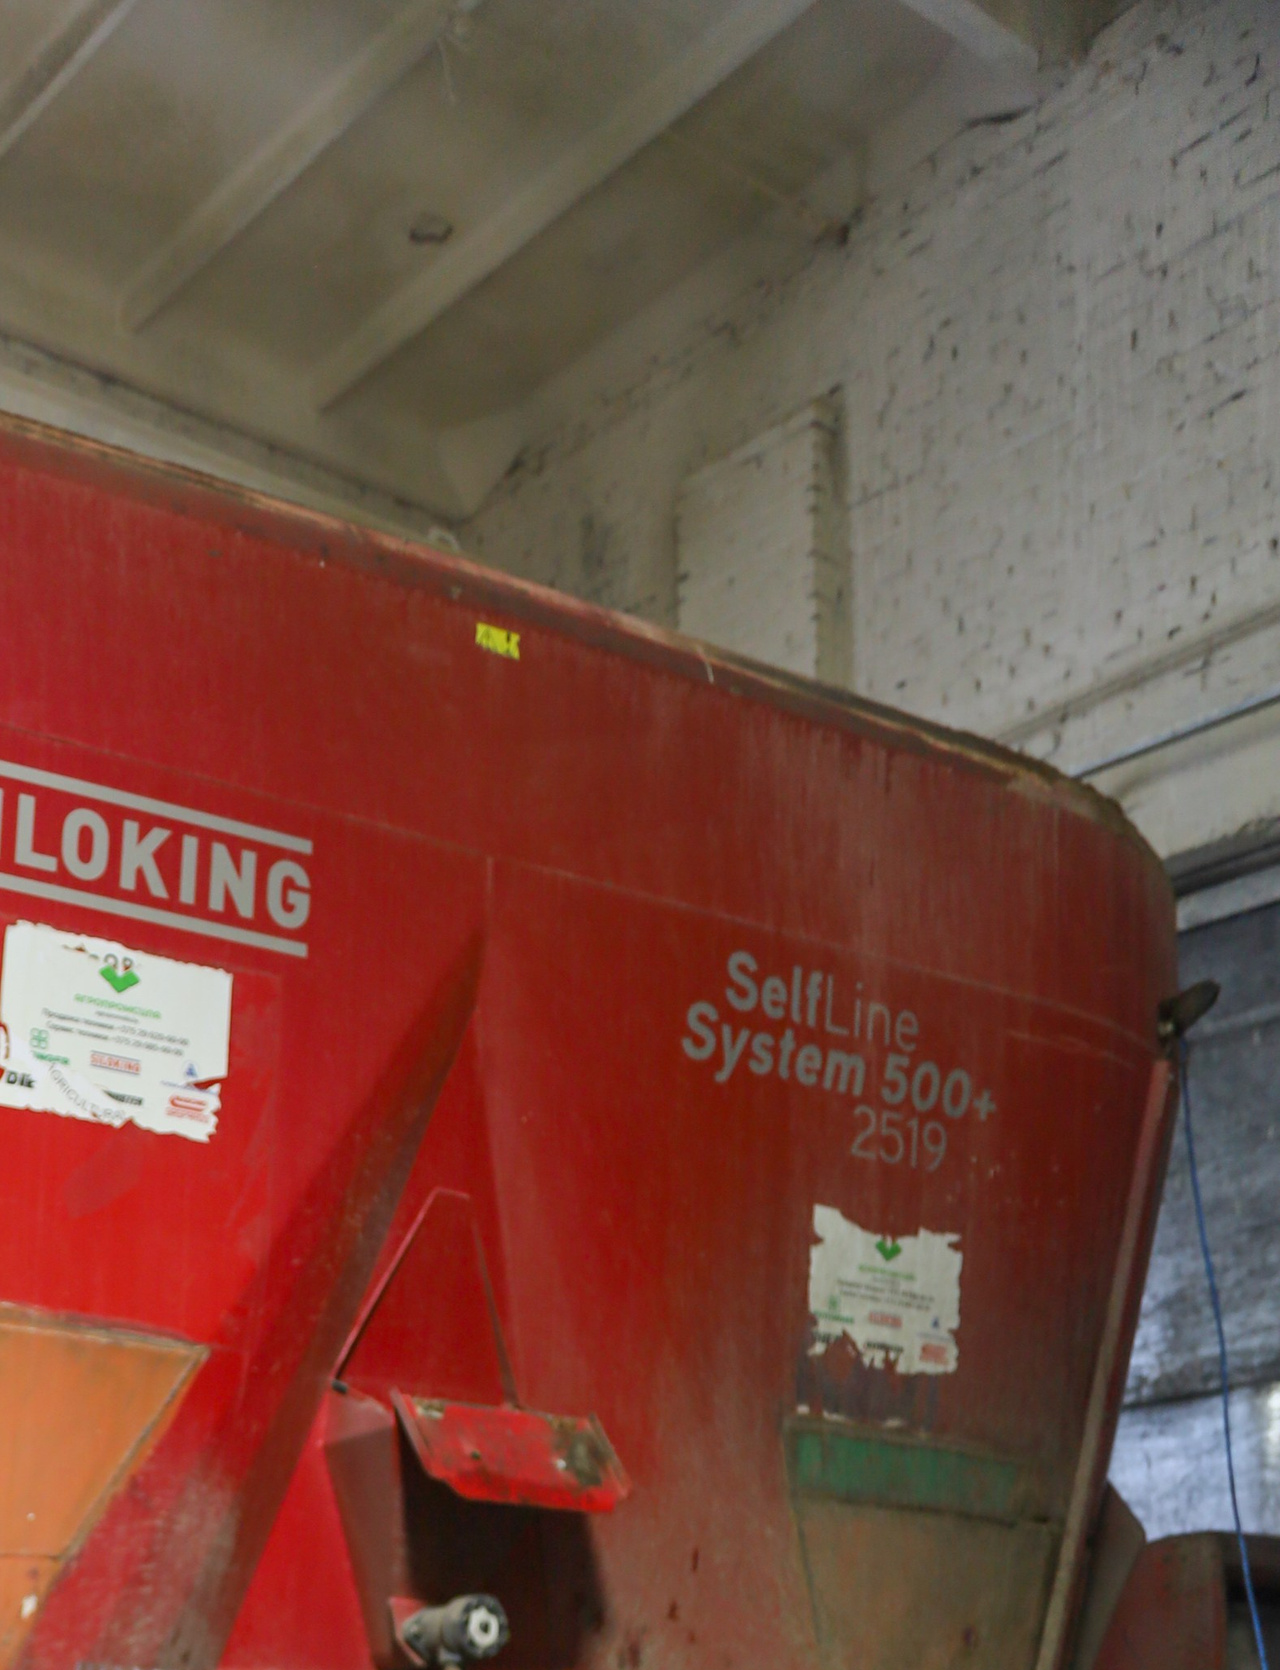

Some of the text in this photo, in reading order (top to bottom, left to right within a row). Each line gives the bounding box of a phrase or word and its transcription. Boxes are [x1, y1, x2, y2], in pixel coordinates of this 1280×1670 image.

[725, 951, 919, 1051] SelfLine
[681, 1002, 997, 1122] System 500+
[850, 1105, 948, 1173] 2519
